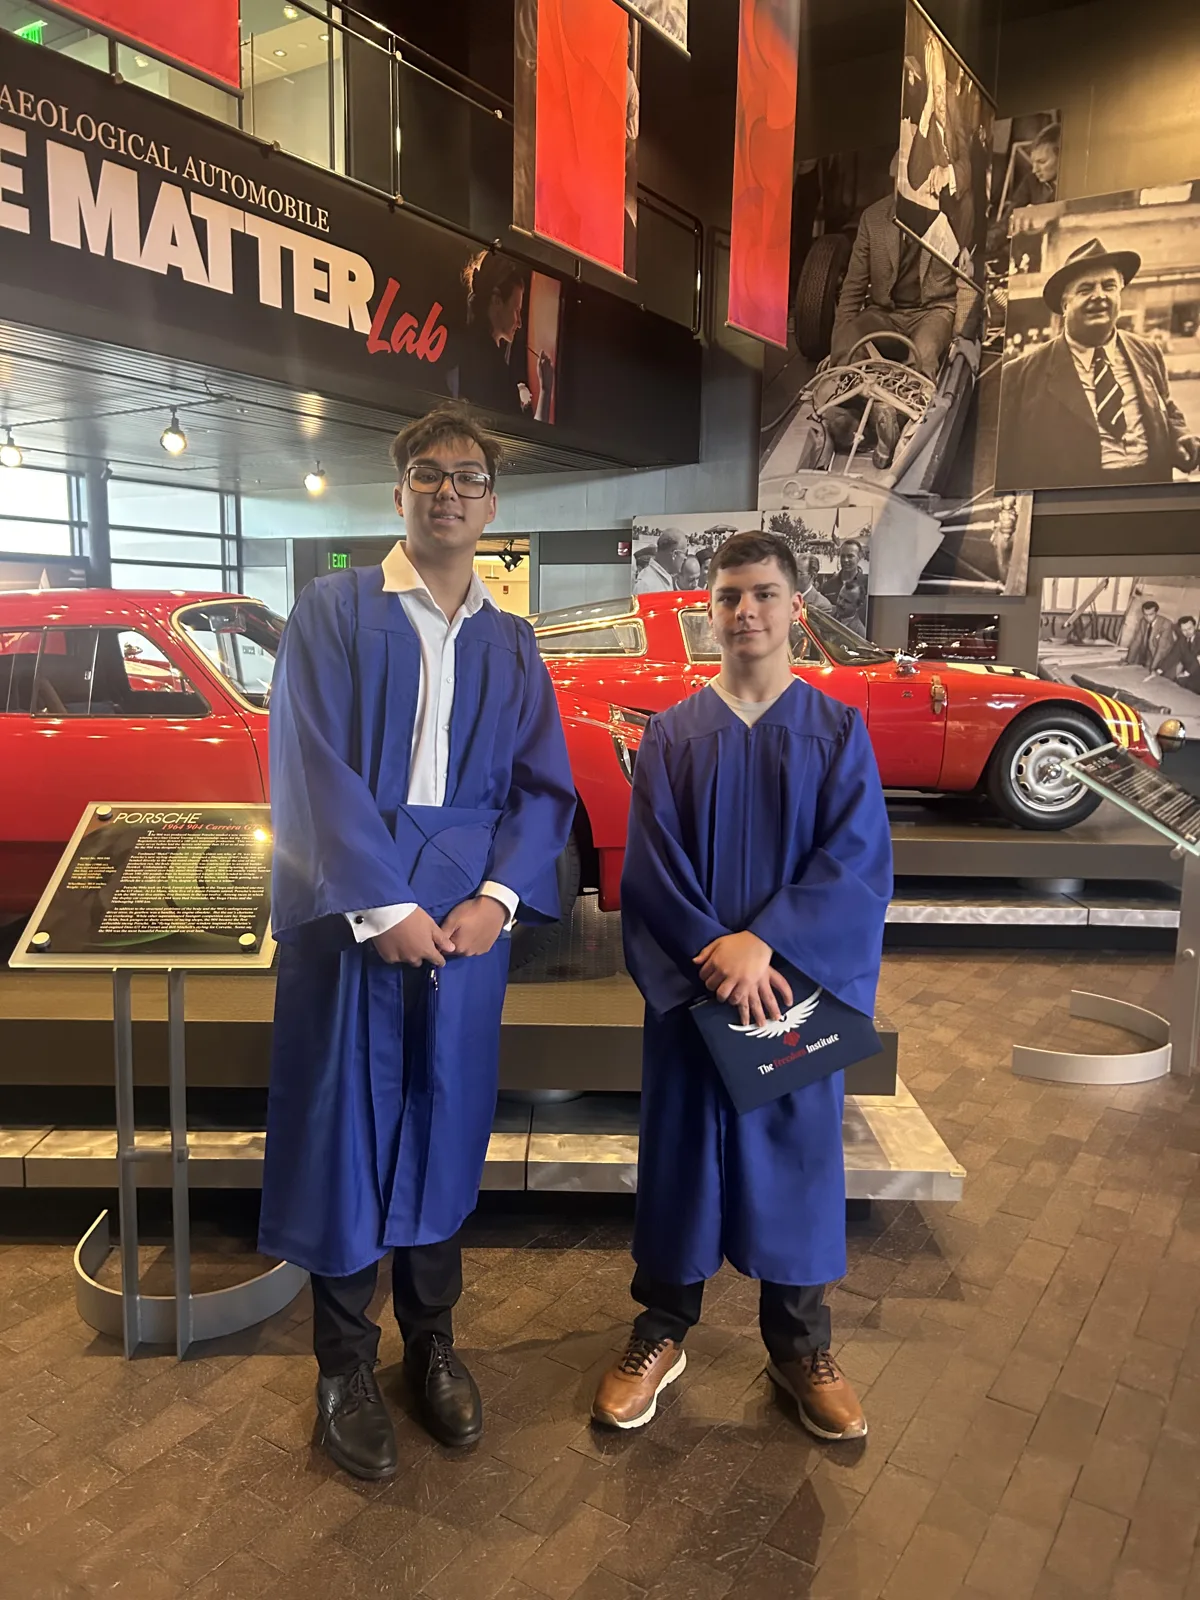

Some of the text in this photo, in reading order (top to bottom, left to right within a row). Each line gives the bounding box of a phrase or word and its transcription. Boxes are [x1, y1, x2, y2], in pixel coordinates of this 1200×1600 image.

[0, 84, 330, 232] AEOLOGICAL AUTOMOBILE
[46, 139, 375, 335] MATTER
[366, 277, 448, 363] Lab
[332, 553, 347, 568] EXIT
[113, 812, 202, 824] PORSCHE
[757, 1063, 774, 1075] The
[805, 1033, 839, 1053] Institute
